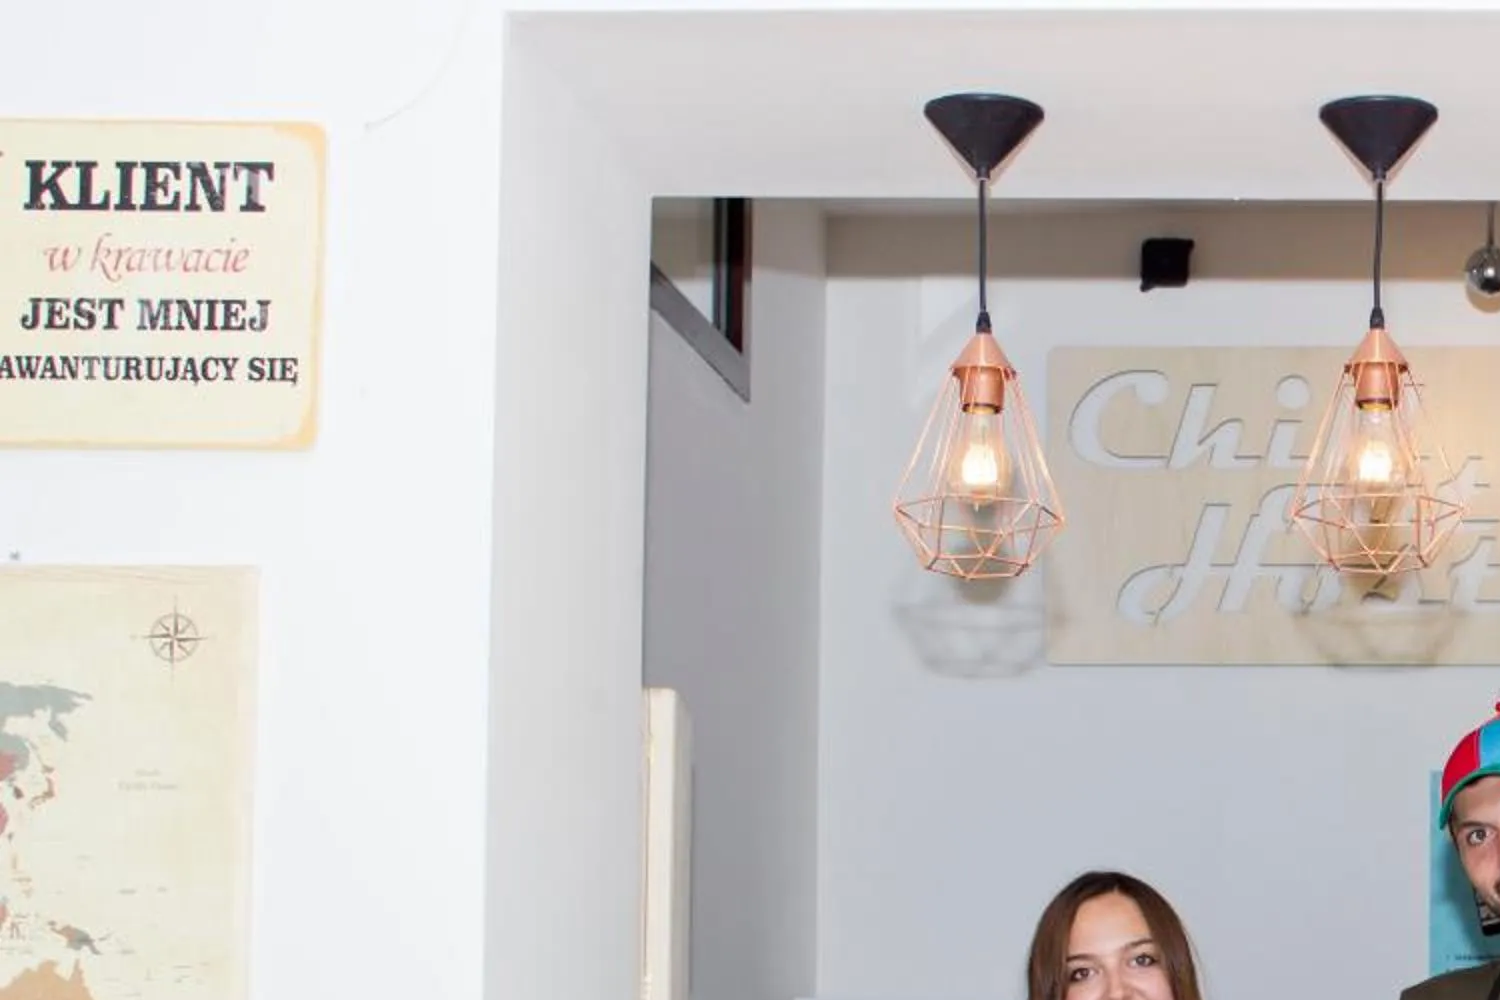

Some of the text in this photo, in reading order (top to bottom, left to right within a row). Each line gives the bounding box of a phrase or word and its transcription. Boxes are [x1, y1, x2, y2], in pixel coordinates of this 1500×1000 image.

[24, 160, 275, 213] KLIENT
[43, 232, 251, 283] w krawacie
[20, 297, 272, 332] JEST MNIEJ
[0, 355, 299, 386] AWANTURUJĄCY SIĘ
[1067, 368, 1434, 470] Chi
